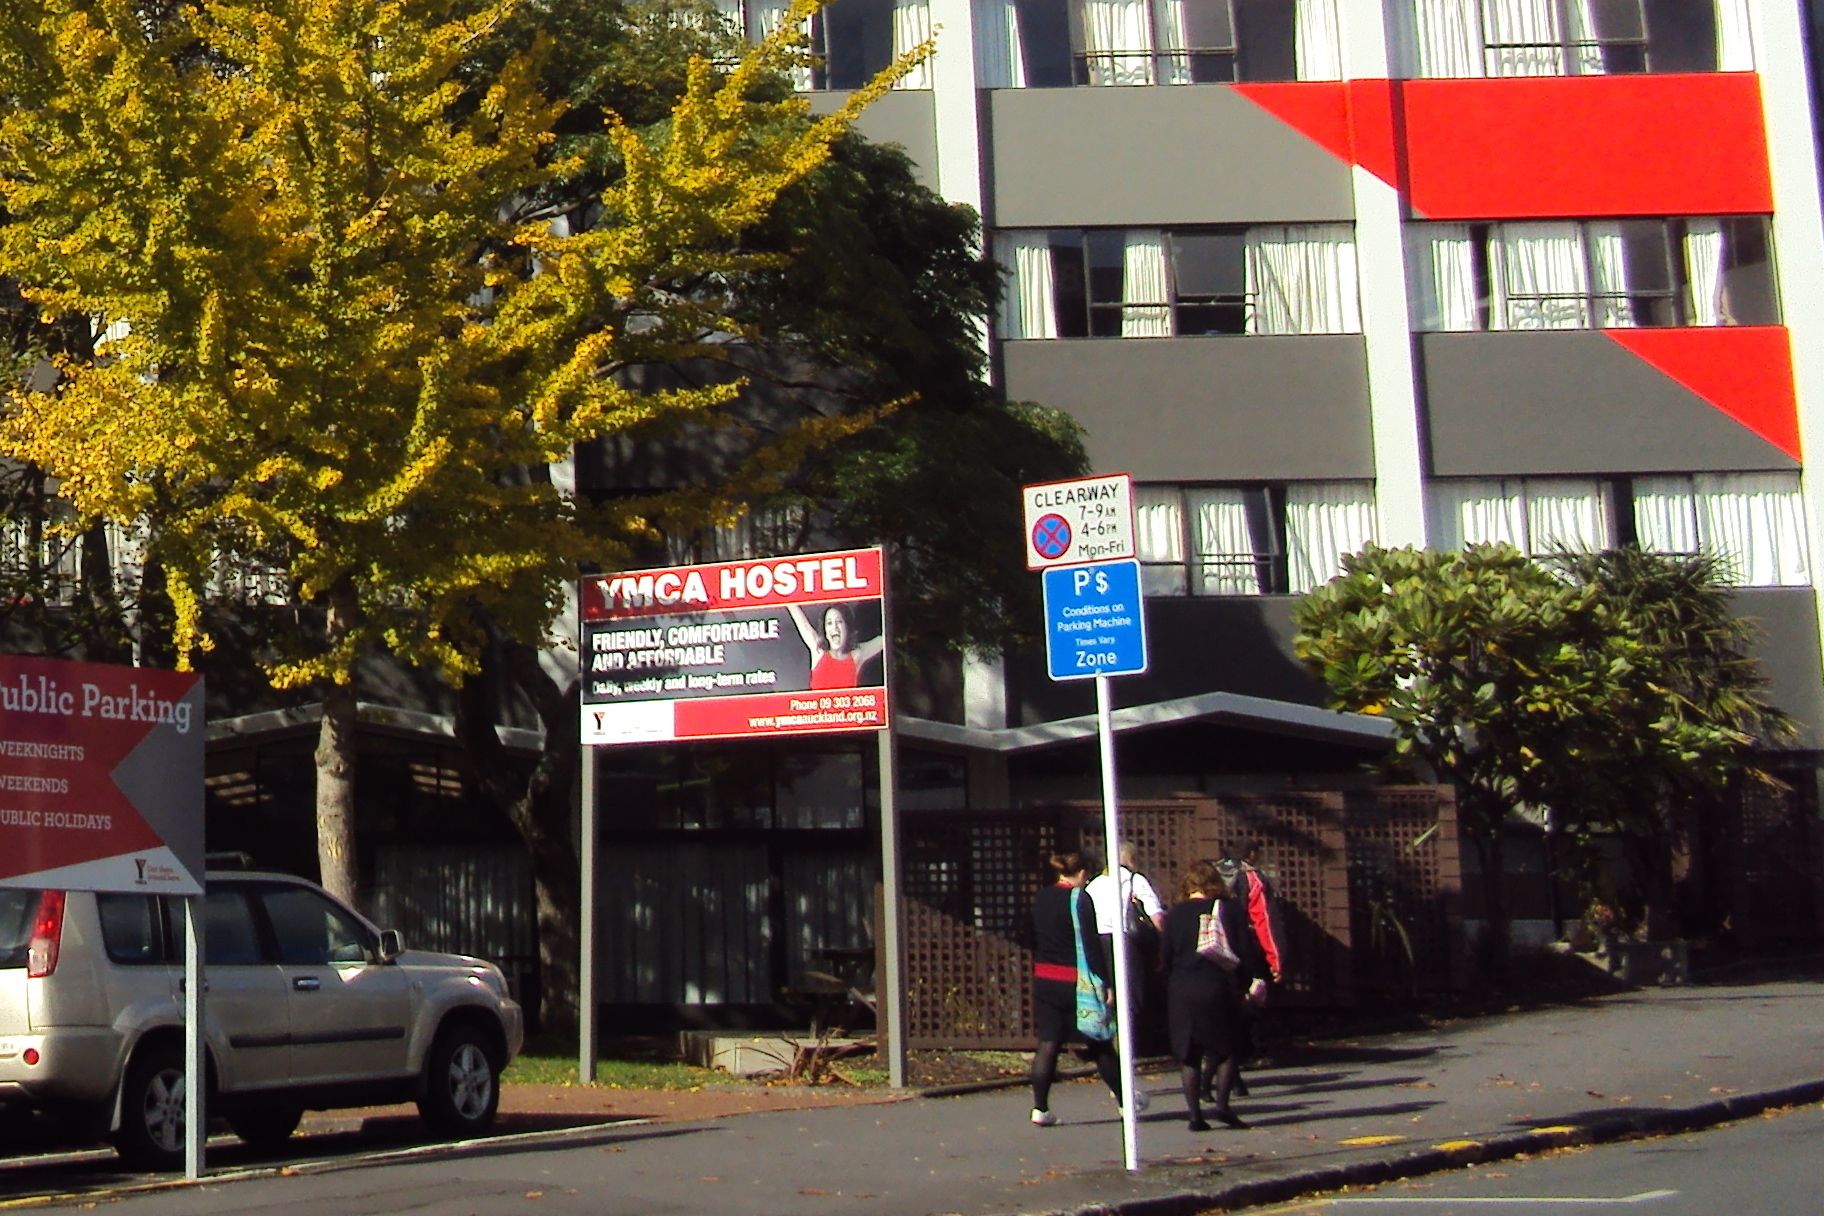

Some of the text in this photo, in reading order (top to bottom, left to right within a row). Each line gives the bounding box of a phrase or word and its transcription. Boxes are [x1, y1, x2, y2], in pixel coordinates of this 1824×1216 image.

[1035, 483, 1118, 508] CLEARWAY
[1078, 540, 1125, 557] Mon-Fri
[597, 556, 868, 609] YMCA HOSTEL
[1062, 603, 1125, 618] Conditions on
[1057, 616, 1132, 632] Parking Machine
[592, 619, 779, 652] FRIENDLY, COMFORTABLE
[592, 645, 726, 672] AND AFFORDABLE
[1075, 650, 1117, 668] Zone
[624, 677, 663, 693] weekly
[664, 676, 687, 690] and
[688, 672, 744, 690] long-term
[746, 670, 776, 684] rates
[82, 684, 192, 733] Parking
[790, 699, 818, 711] Phone
[819, 698, 832, 709] 09
[44, 811, 112, 830] HOLIDAYS
